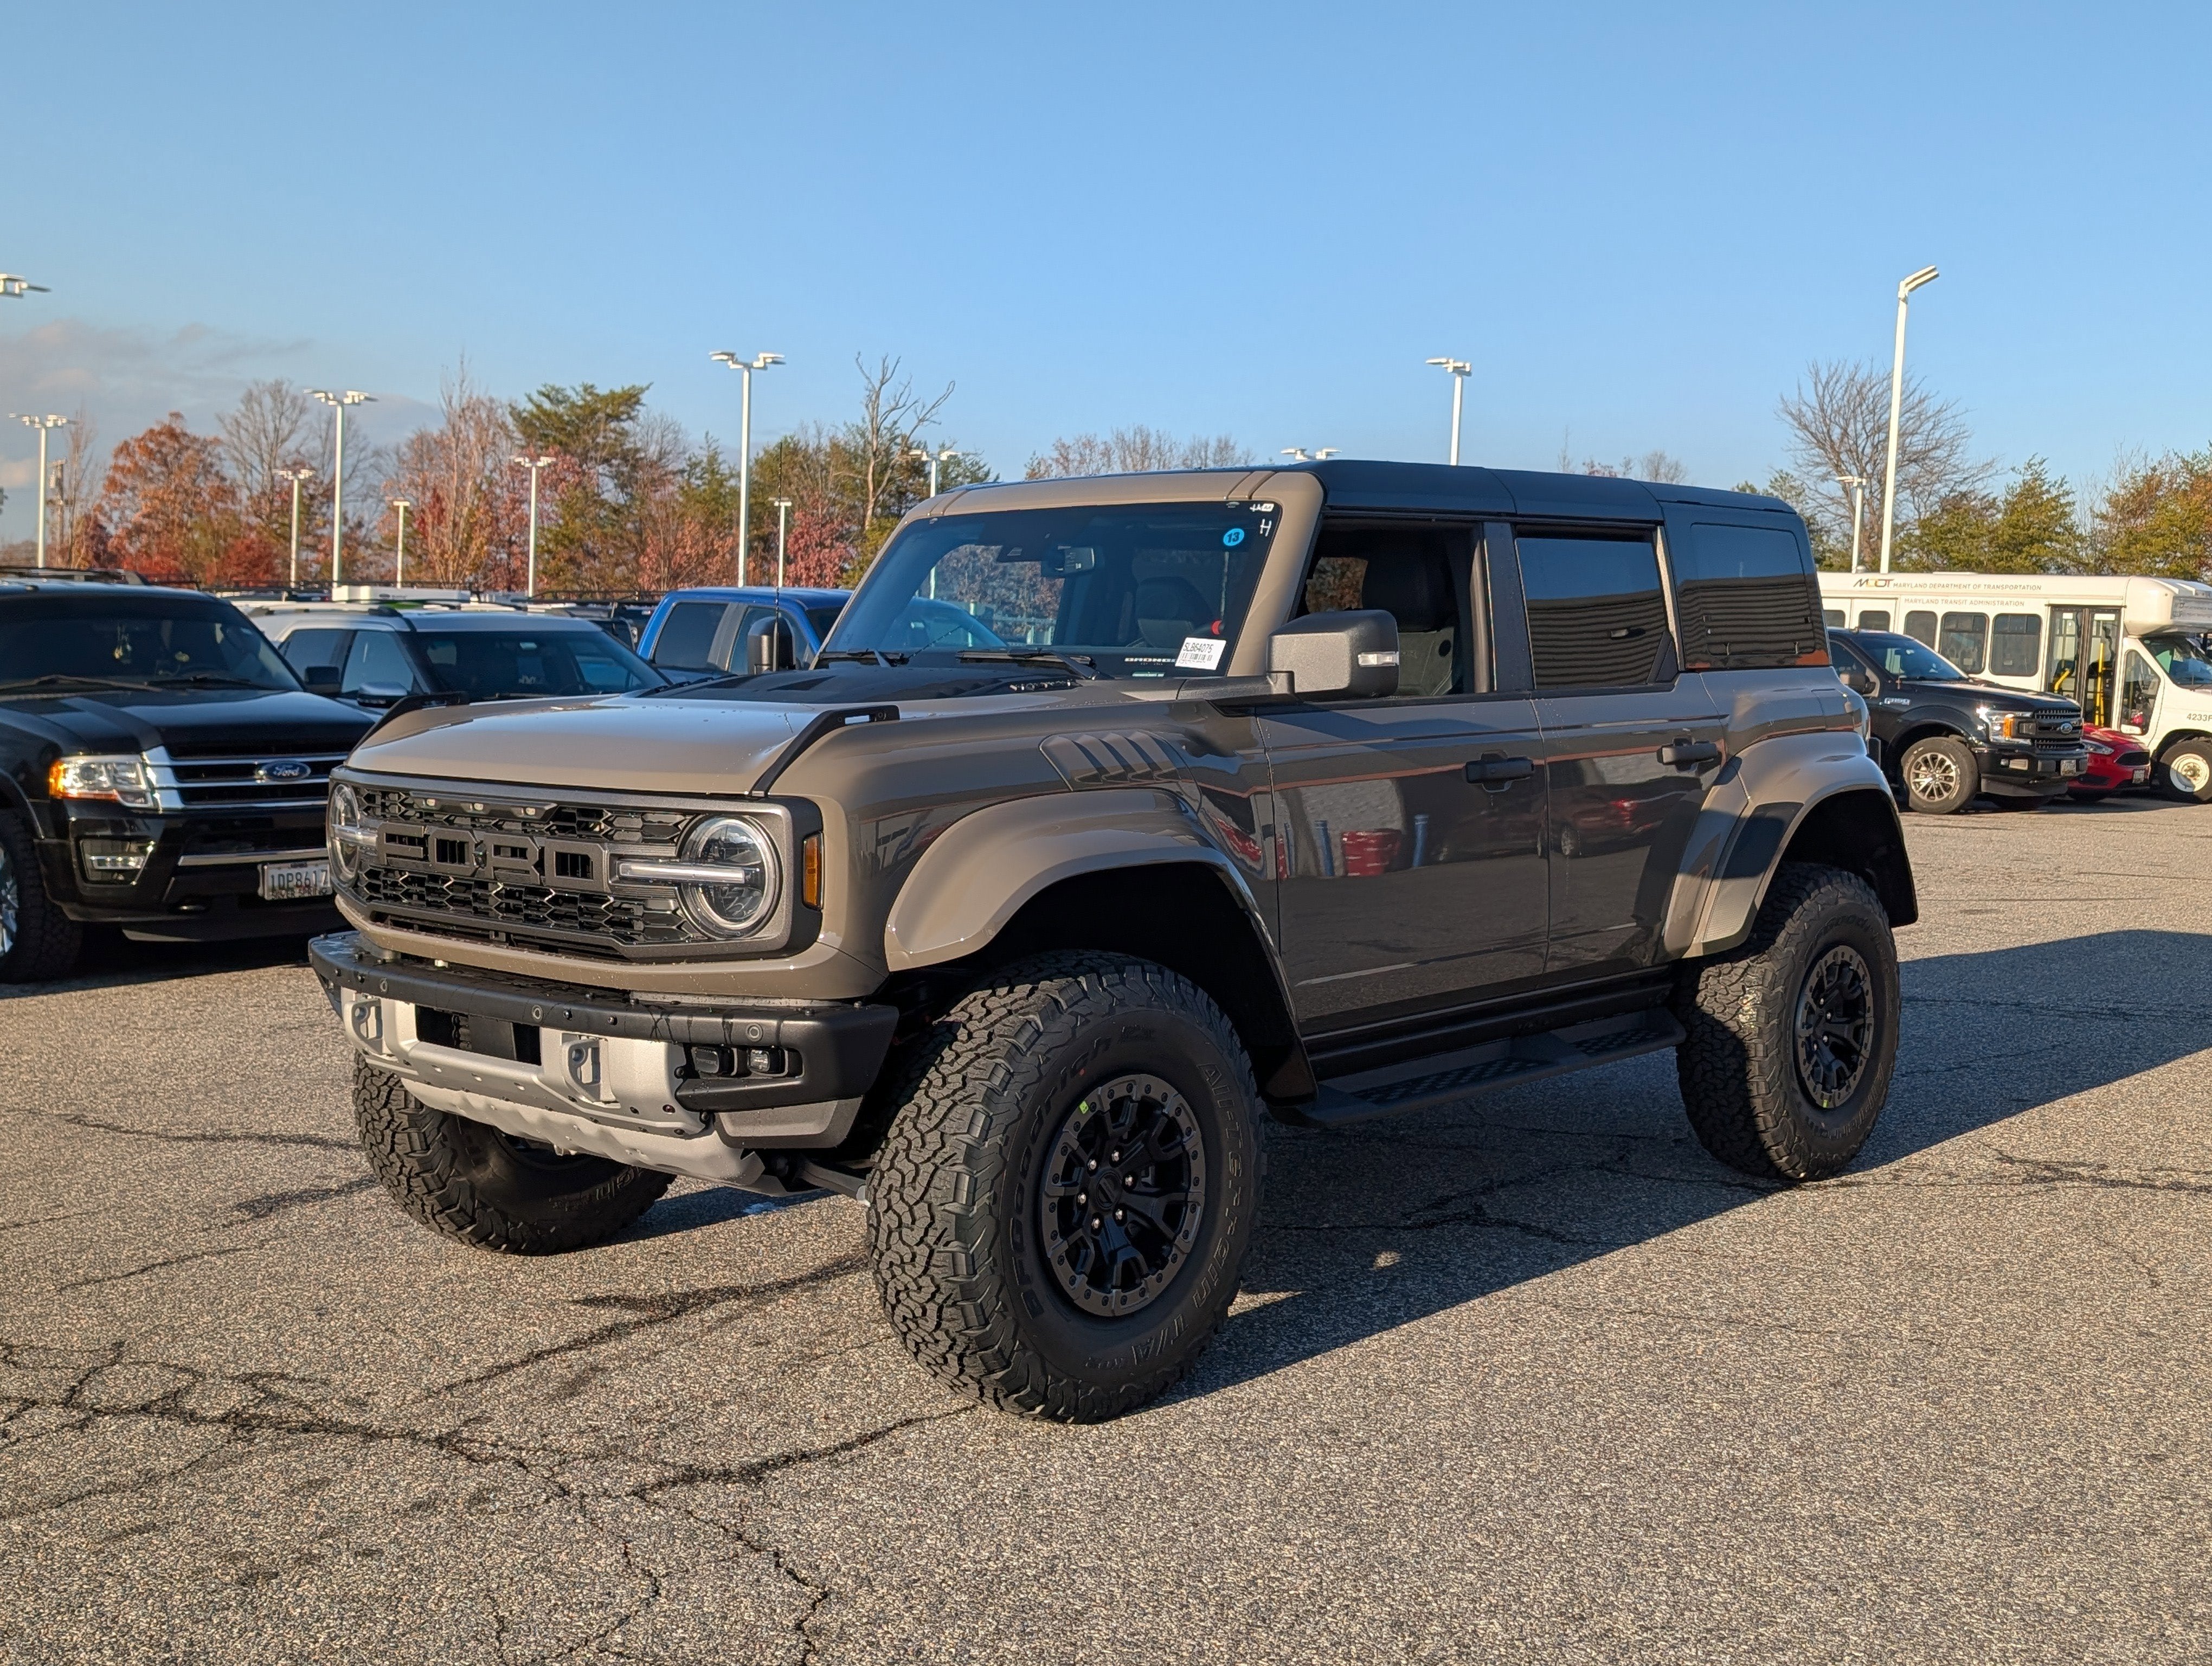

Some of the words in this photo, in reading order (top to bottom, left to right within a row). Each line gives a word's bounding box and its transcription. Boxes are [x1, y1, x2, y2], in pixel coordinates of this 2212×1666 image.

[1227, 531, 1241, 543] 13
[273, 765, 300, 777] Ford
[376, 821, 610, 893] FORD
[1010, 1036, 1111, 1319] BFGoodrich
[1131, 1314, 1189, 1366] T/A
